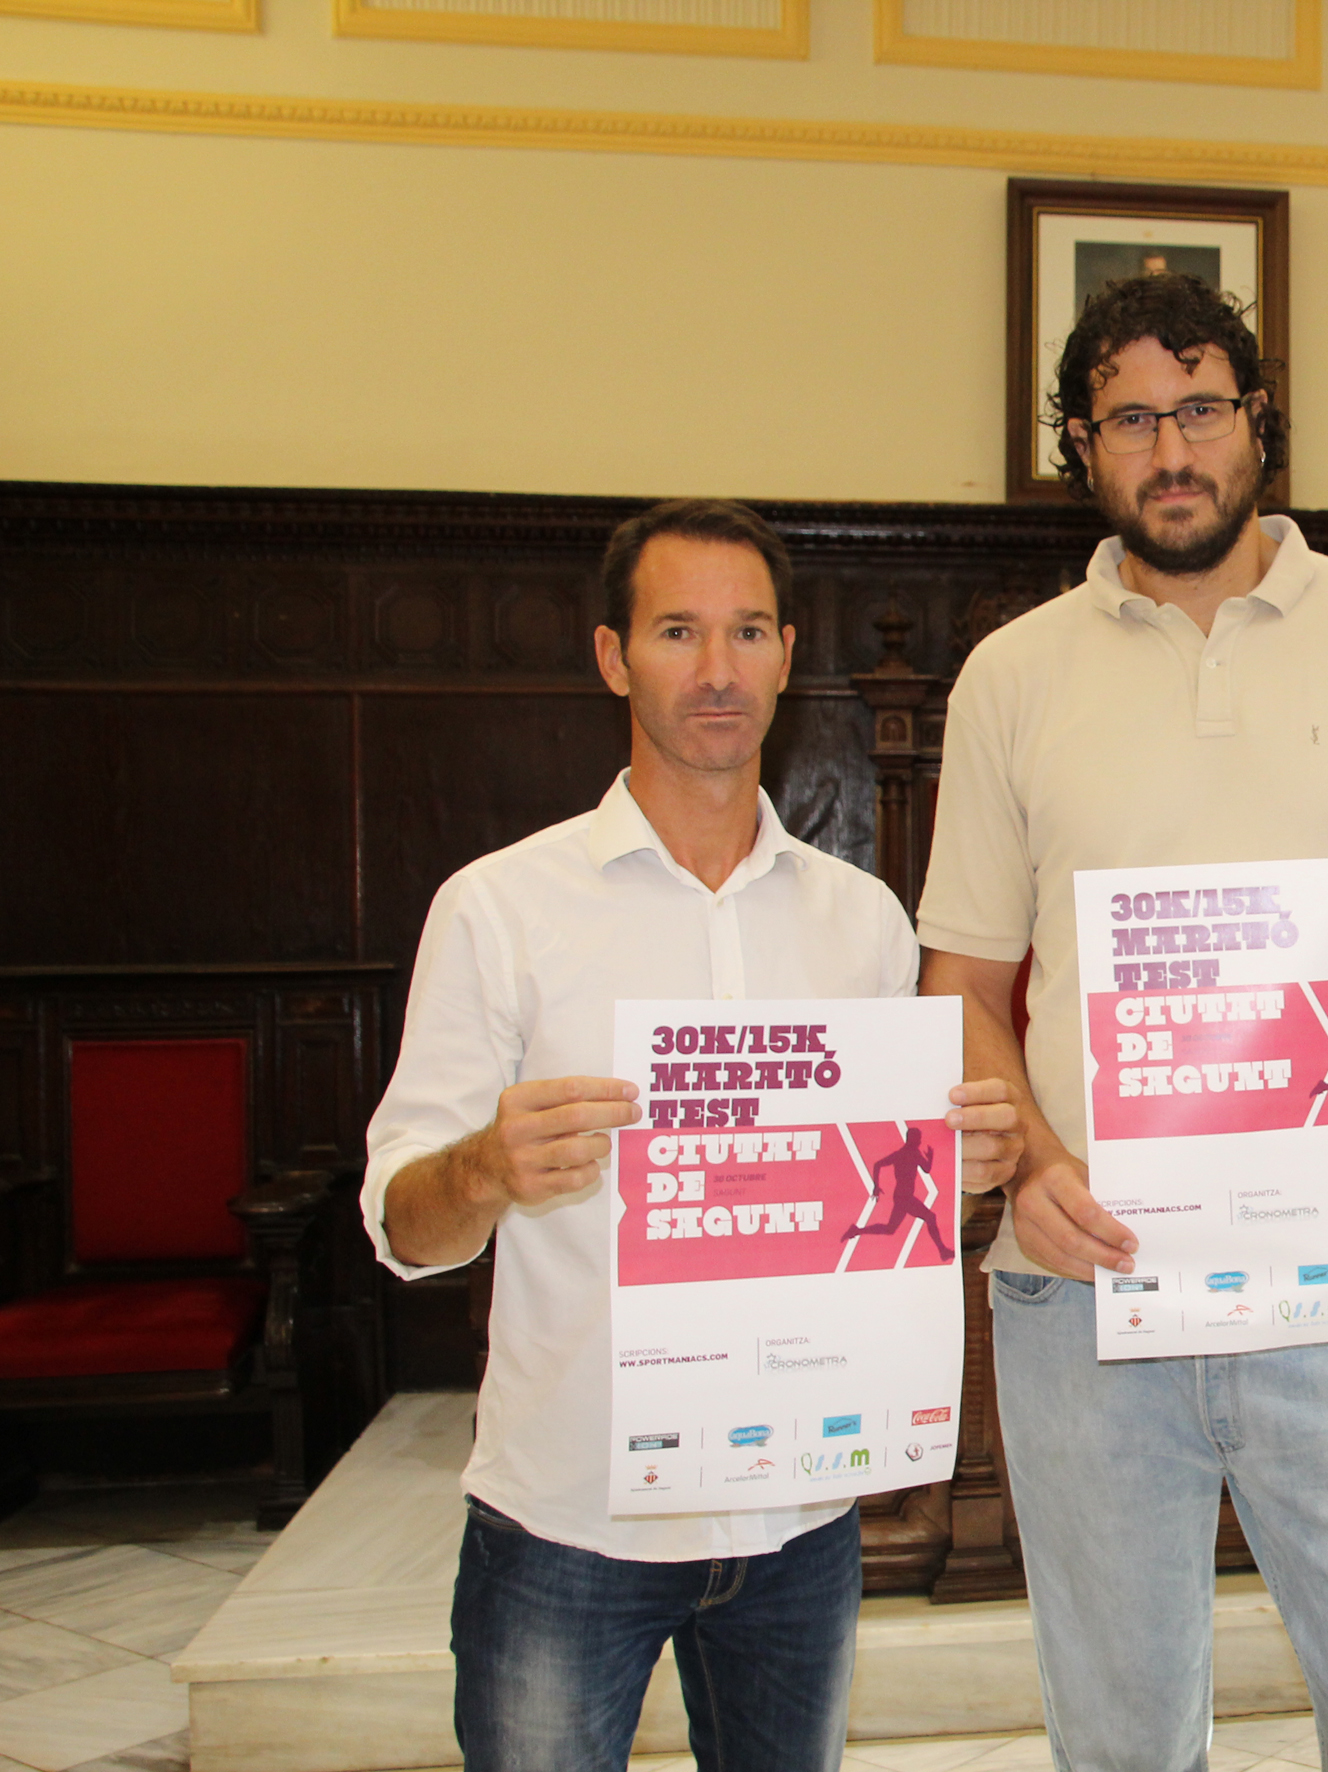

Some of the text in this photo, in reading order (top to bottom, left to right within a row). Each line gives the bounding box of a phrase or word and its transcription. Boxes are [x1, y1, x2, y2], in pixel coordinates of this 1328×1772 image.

[1111, 911, 1299, 957] MARATÓ
[1113, 958, 1220, 992] TEST
[1115, 990, 1285, 1027] CIUTAT
[1116, 1031, 1173, 1062] DE
[650, 1050, 841, 1092] MARATÓ
[1118, 1058, 1292, 1098] SAGUNT
[649, 1098, 759, 1129] TEST
[647, 1130, 821, 1166] CIUTAT
[646, 1171, 705, 1203] DE
[725, 1173, 767, 1182] OCTUBRE
[646, 1201, 823, 1240] SAGUNT
[1243, 1206, 1320, 1221] CRONOMETRA
[1205, 1318, 1248, 1328] ArcelorMittal
[770, 1356, 848, 1370] CRONOMETRA
[724, 1472, 769, 1484] ArcelorMittal
